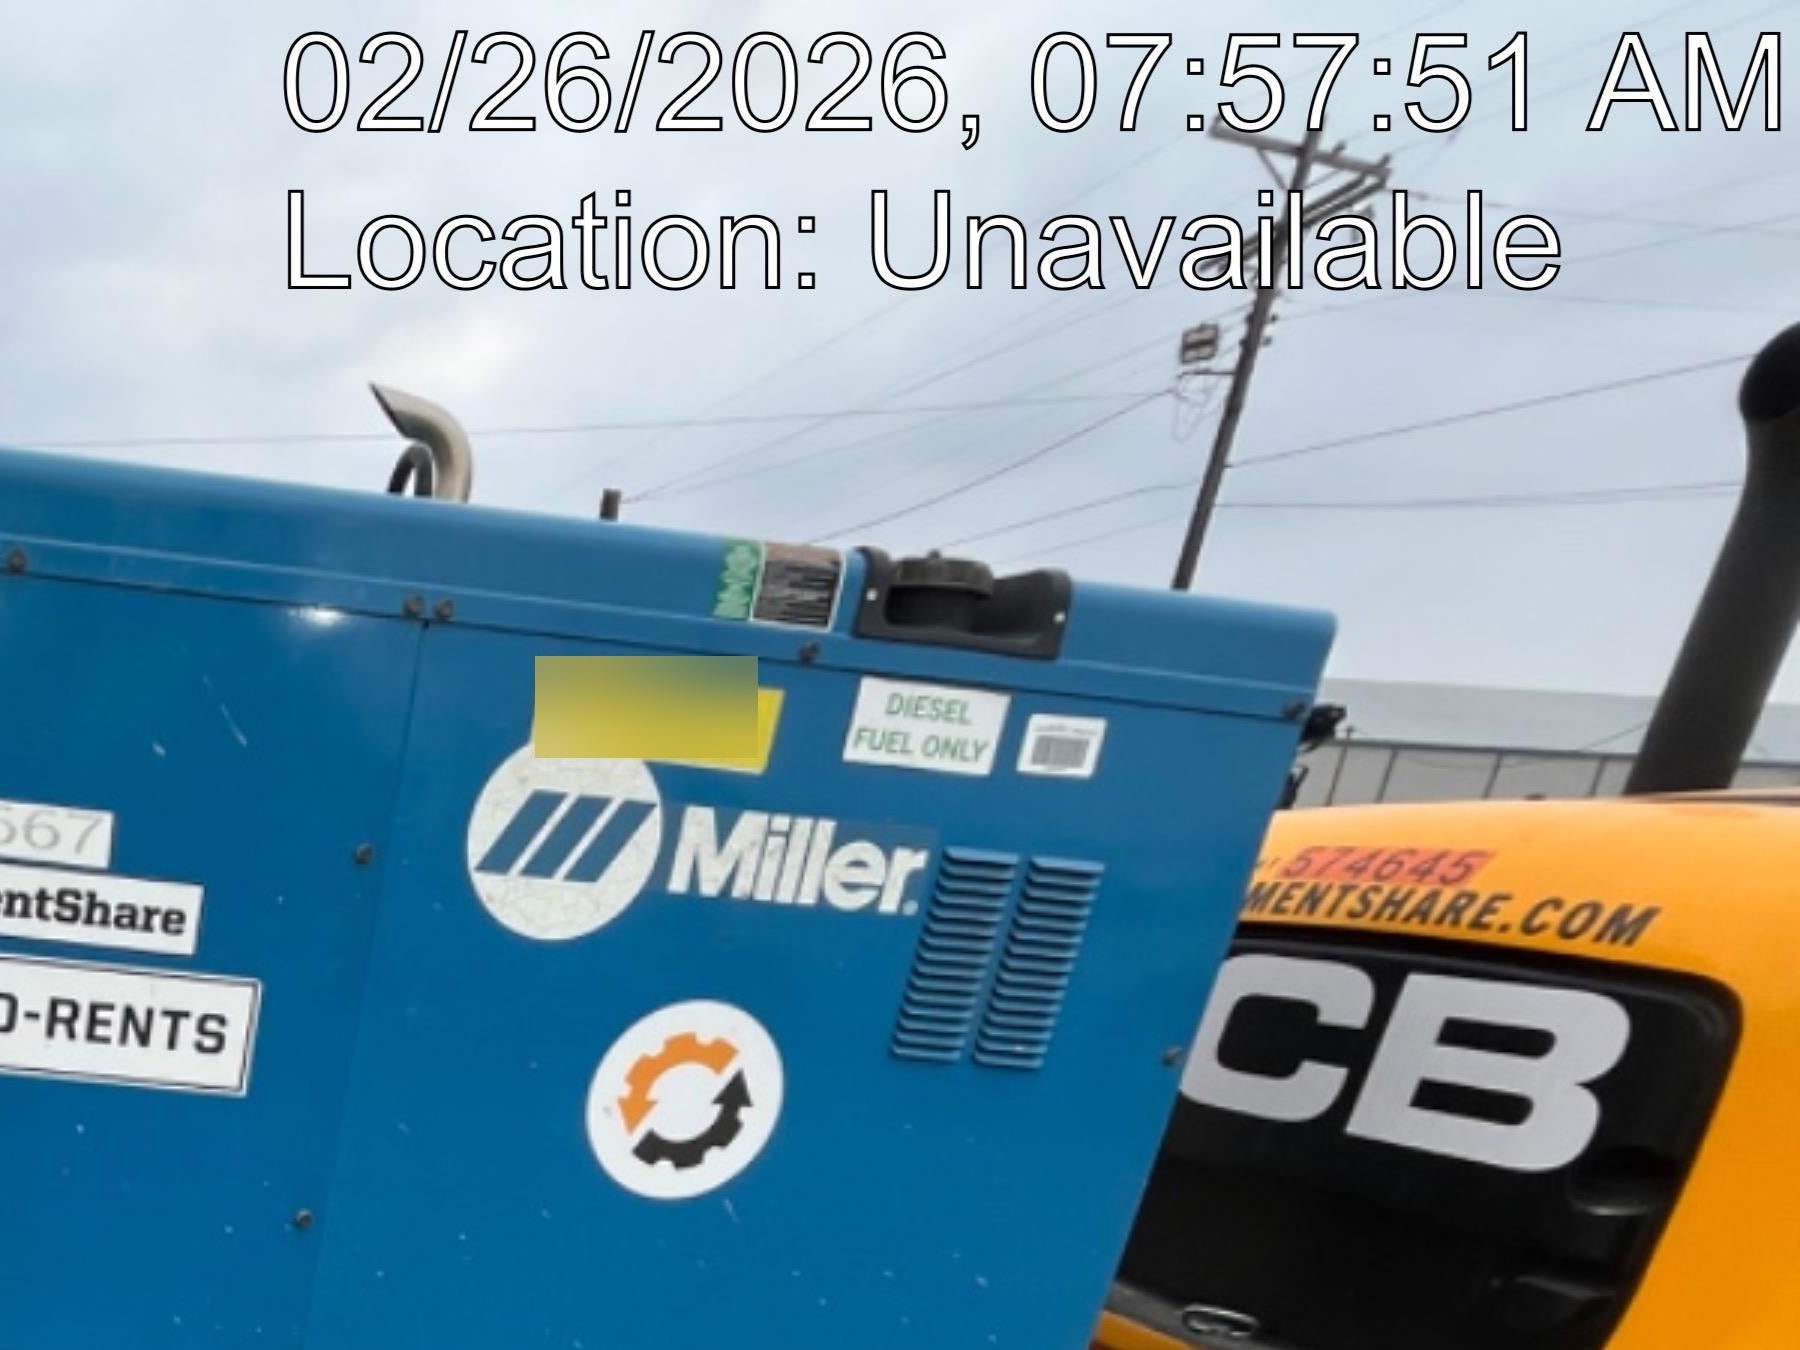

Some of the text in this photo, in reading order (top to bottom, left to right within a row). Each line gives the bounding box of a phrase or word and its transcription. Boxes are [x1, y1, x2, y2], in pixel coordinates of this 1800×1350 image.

[885, 692, 972, 725] DIESEL
[852, 727, 991, 763] FUEL ONLY
[1281, 845, 1491, 887] 574645
